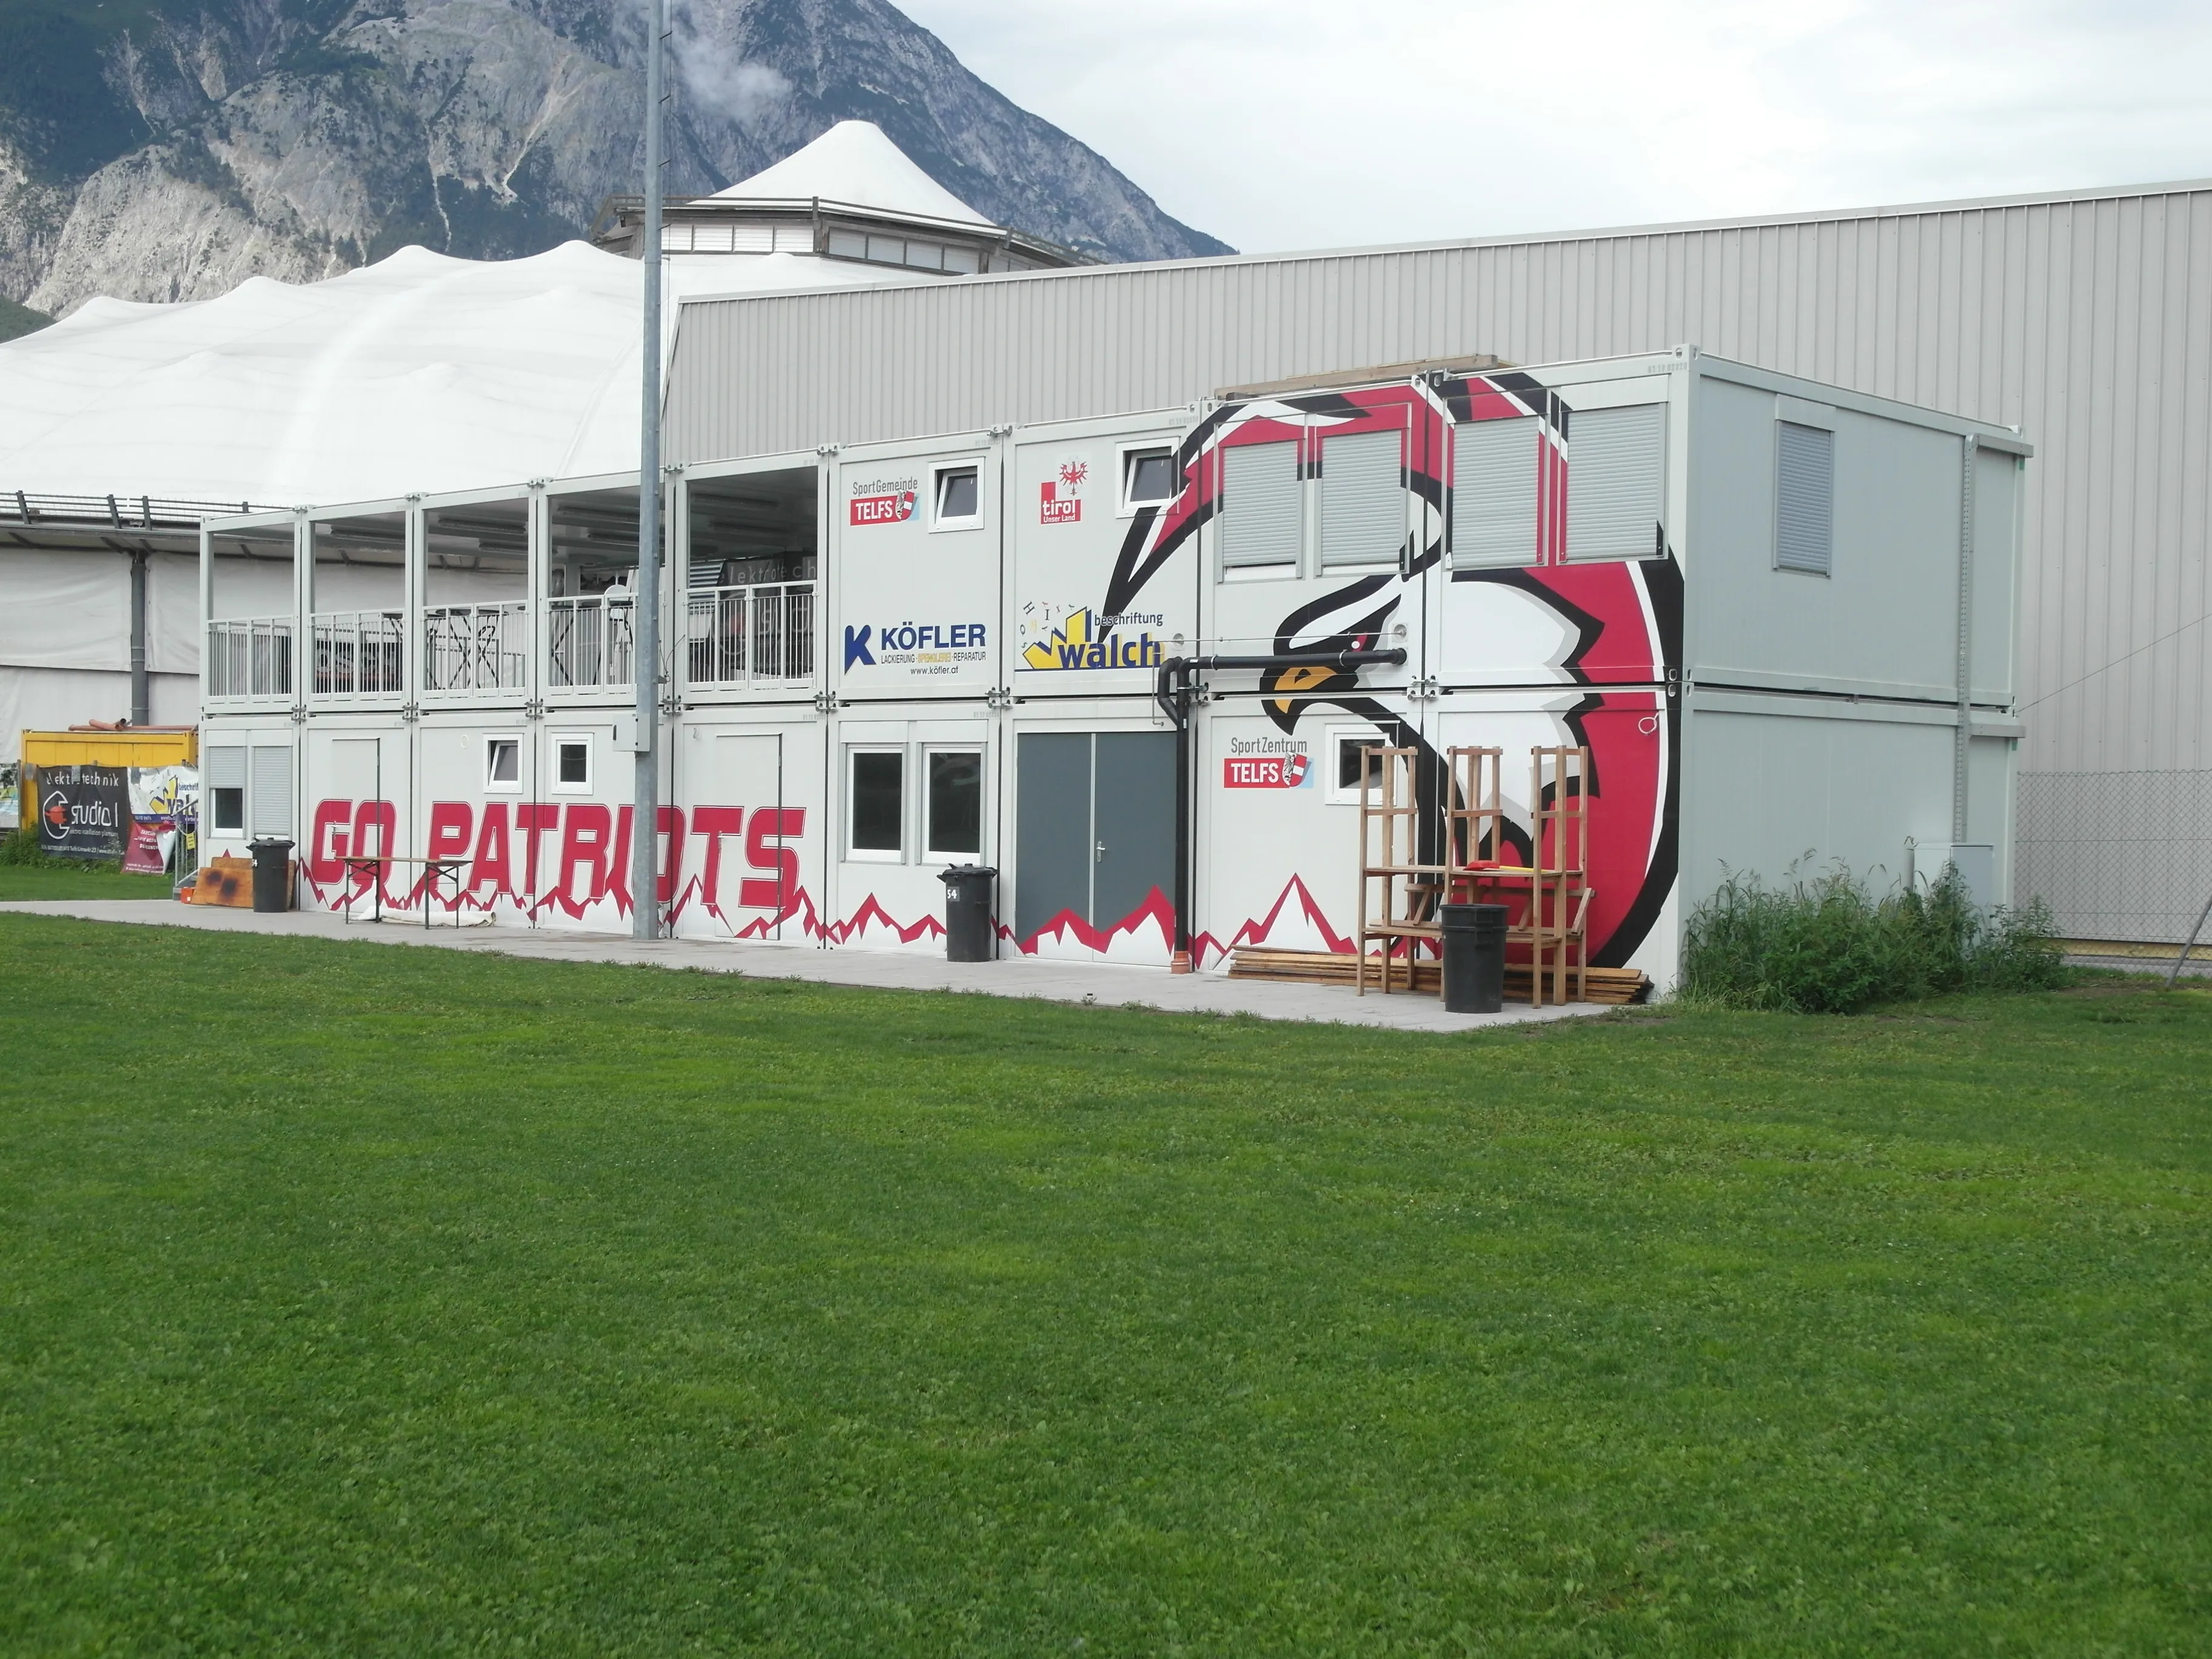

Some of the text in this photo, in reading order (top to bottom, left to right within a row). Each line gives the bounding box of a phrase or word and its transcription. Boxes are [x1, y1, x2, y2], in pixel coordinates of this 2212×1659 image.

[853, 477, 918, 497] SportGemeinde
[856, 500, 893, 520] TELFS
[1043, 500, 1076, 515] tirol
[1094, 612, 1163, 627] beschriftung
[881, 621, 986, 651] KÖFLER
[881, 653, 915, 664] LACKIERUNG
[953, 651, 987, 662] REPARATUR
[1057, 632, 1162, 669] walch
[910, 665, 959, 675] www.köfler.at
[1231, 737, 1307, 756] SportZentrum
[1231, 763, 1279, 783] TELFS
[310, 799, 806, 909] GO PATRIOTS
[947, 889, 957, 899] 54
